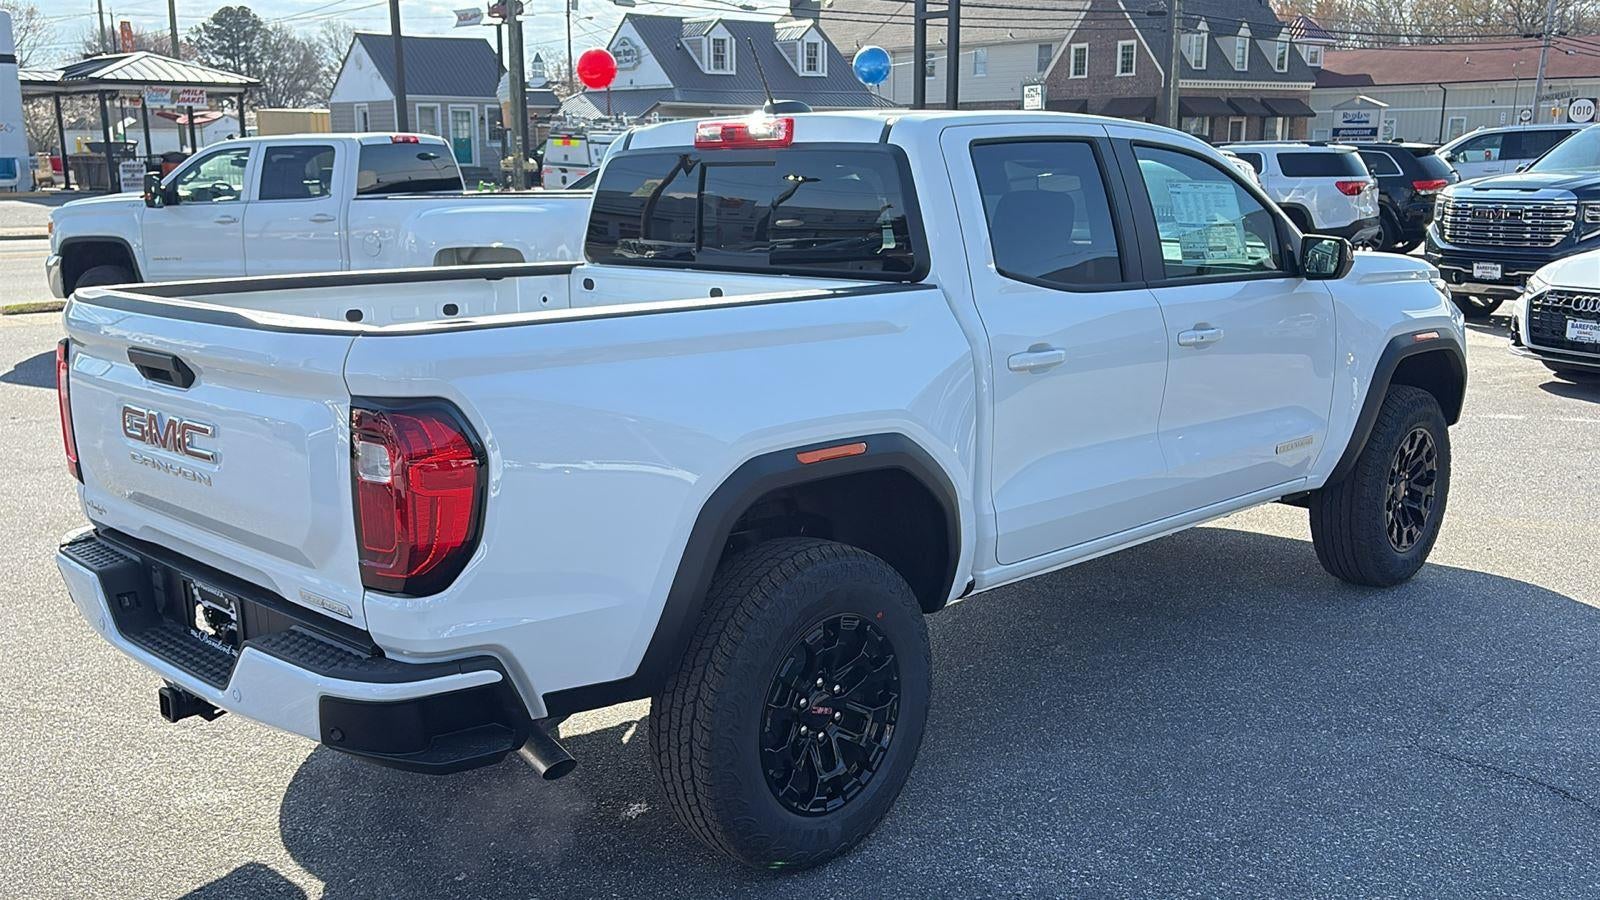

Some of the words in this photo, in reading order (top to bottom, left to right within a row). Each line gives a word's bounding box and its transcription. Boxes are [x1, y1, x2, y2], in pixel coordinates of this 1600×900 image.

[182, 89, 205, 97] MILK
[1572, 106, 1592, 116] 1010
[1475, 209, 1522, 220] GMC
[122, 404, 217, 464] GMC
[129, 451, 212, 487] CANYON
